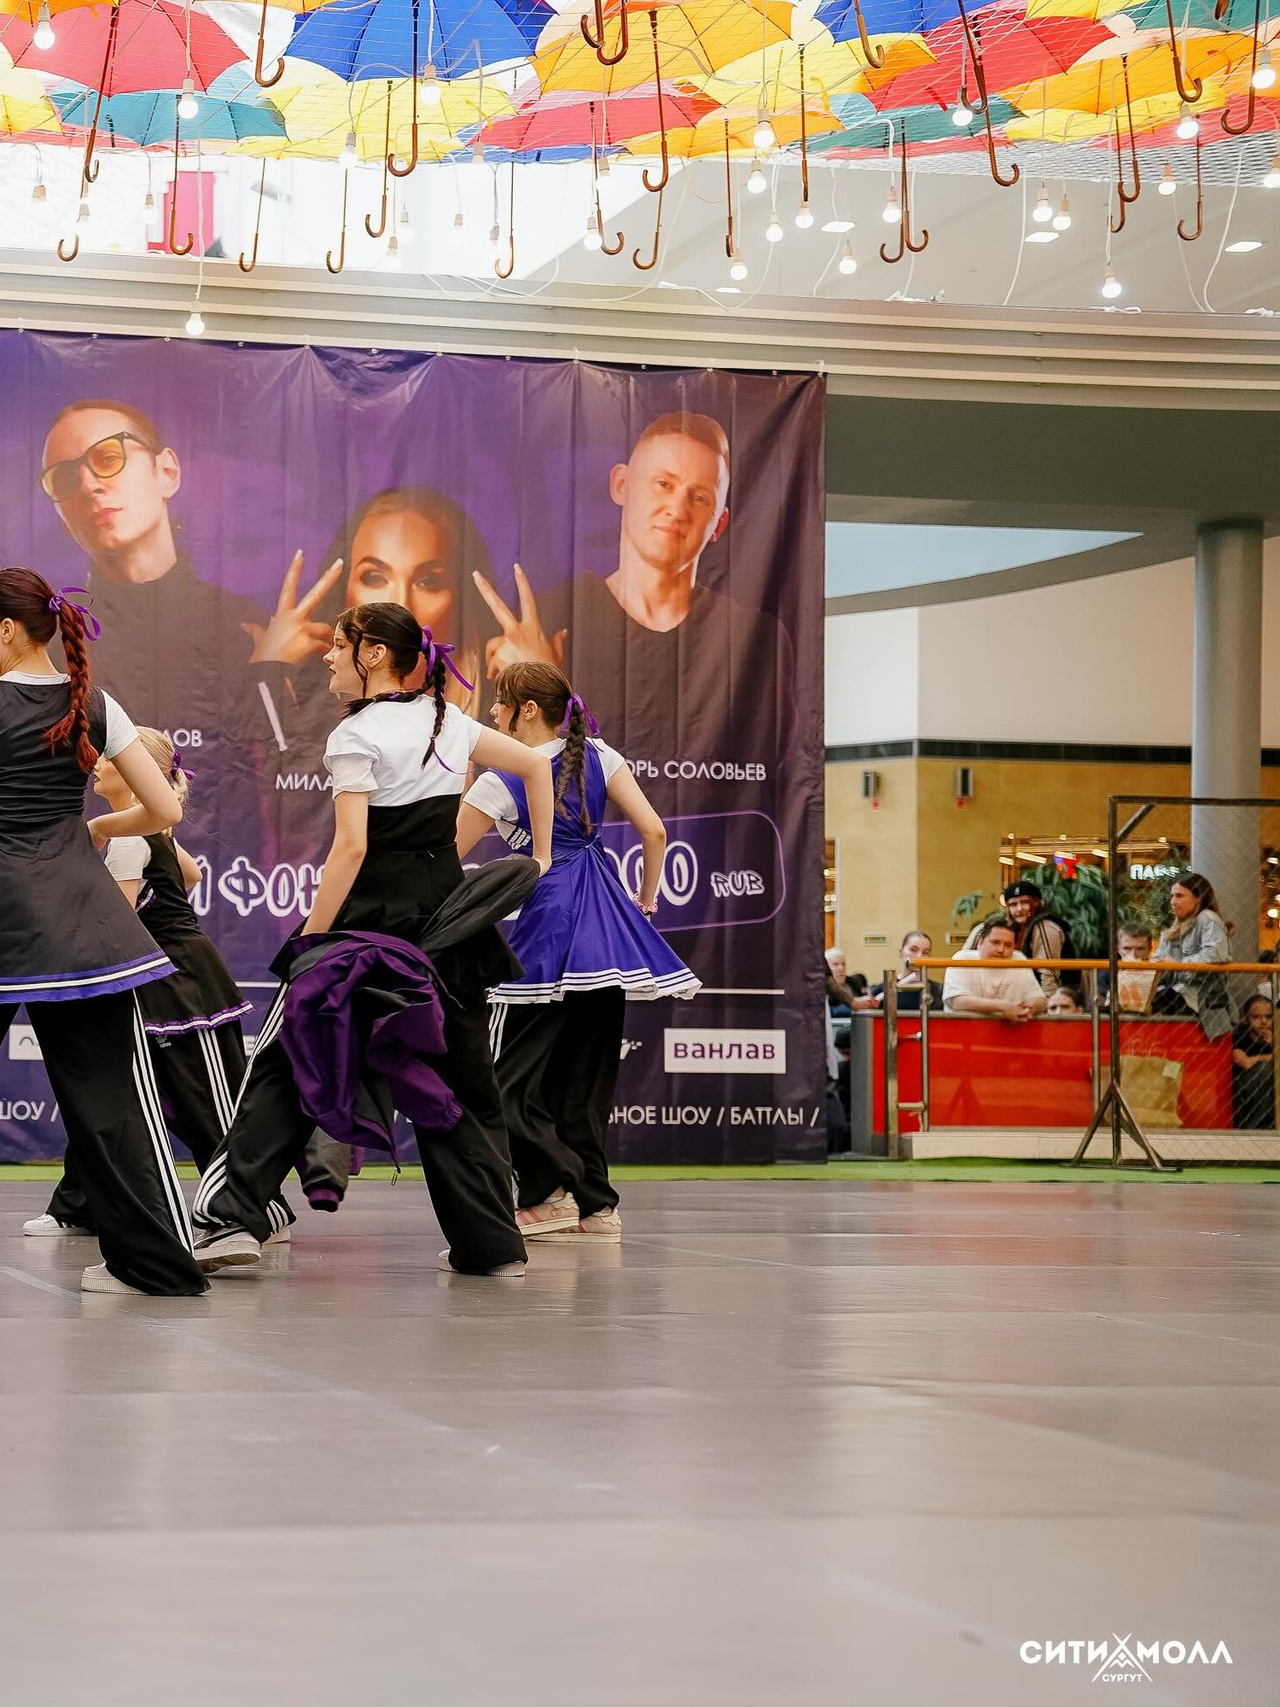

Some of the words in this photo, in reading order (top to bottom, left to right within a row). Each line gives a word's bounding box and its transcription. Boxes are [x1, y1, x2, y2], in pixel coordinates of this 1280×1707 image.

[663, 760, 767, 781] СОЛОВЬЕВ
[709, 869, 765, 899] RUB
[673, 1042, 776, 1060] ванлав
[661, 1106, 712, 1125] ШОУ
[730, 1107, 804, 1126] БАТТЛЫ
